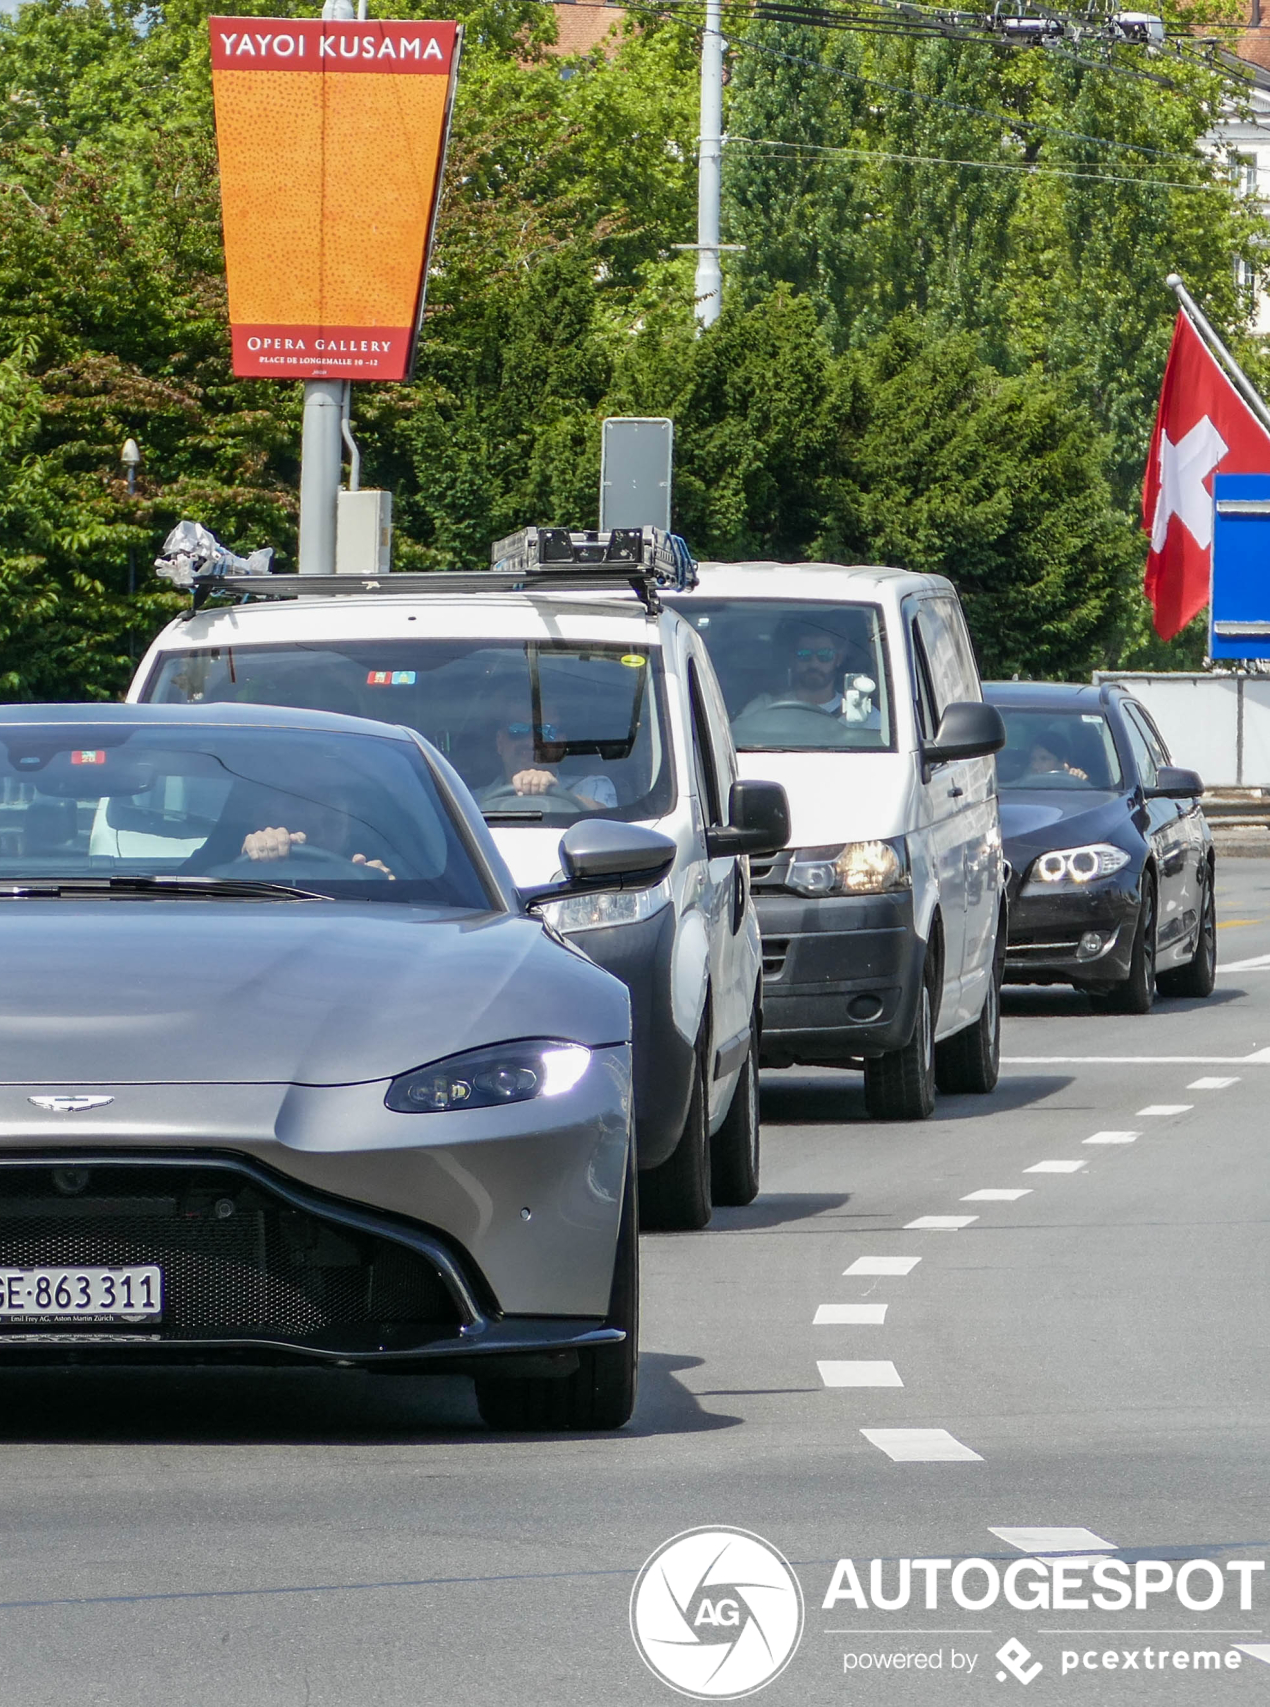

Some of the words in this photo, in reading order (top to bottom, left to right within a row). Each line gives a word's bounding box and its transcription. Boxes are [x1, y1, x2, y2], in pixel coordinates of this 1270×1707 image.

[220, 33, 304, 57] YAYOI
[319, 35, 443, 60] KUSAMA
[247, 337, 306, 350] OPERA
[315, 339, 391, 352] GALLERY
[299, 357, 352, 365] LONGEMALLE
[100, 1275, 155, 1308] 311
